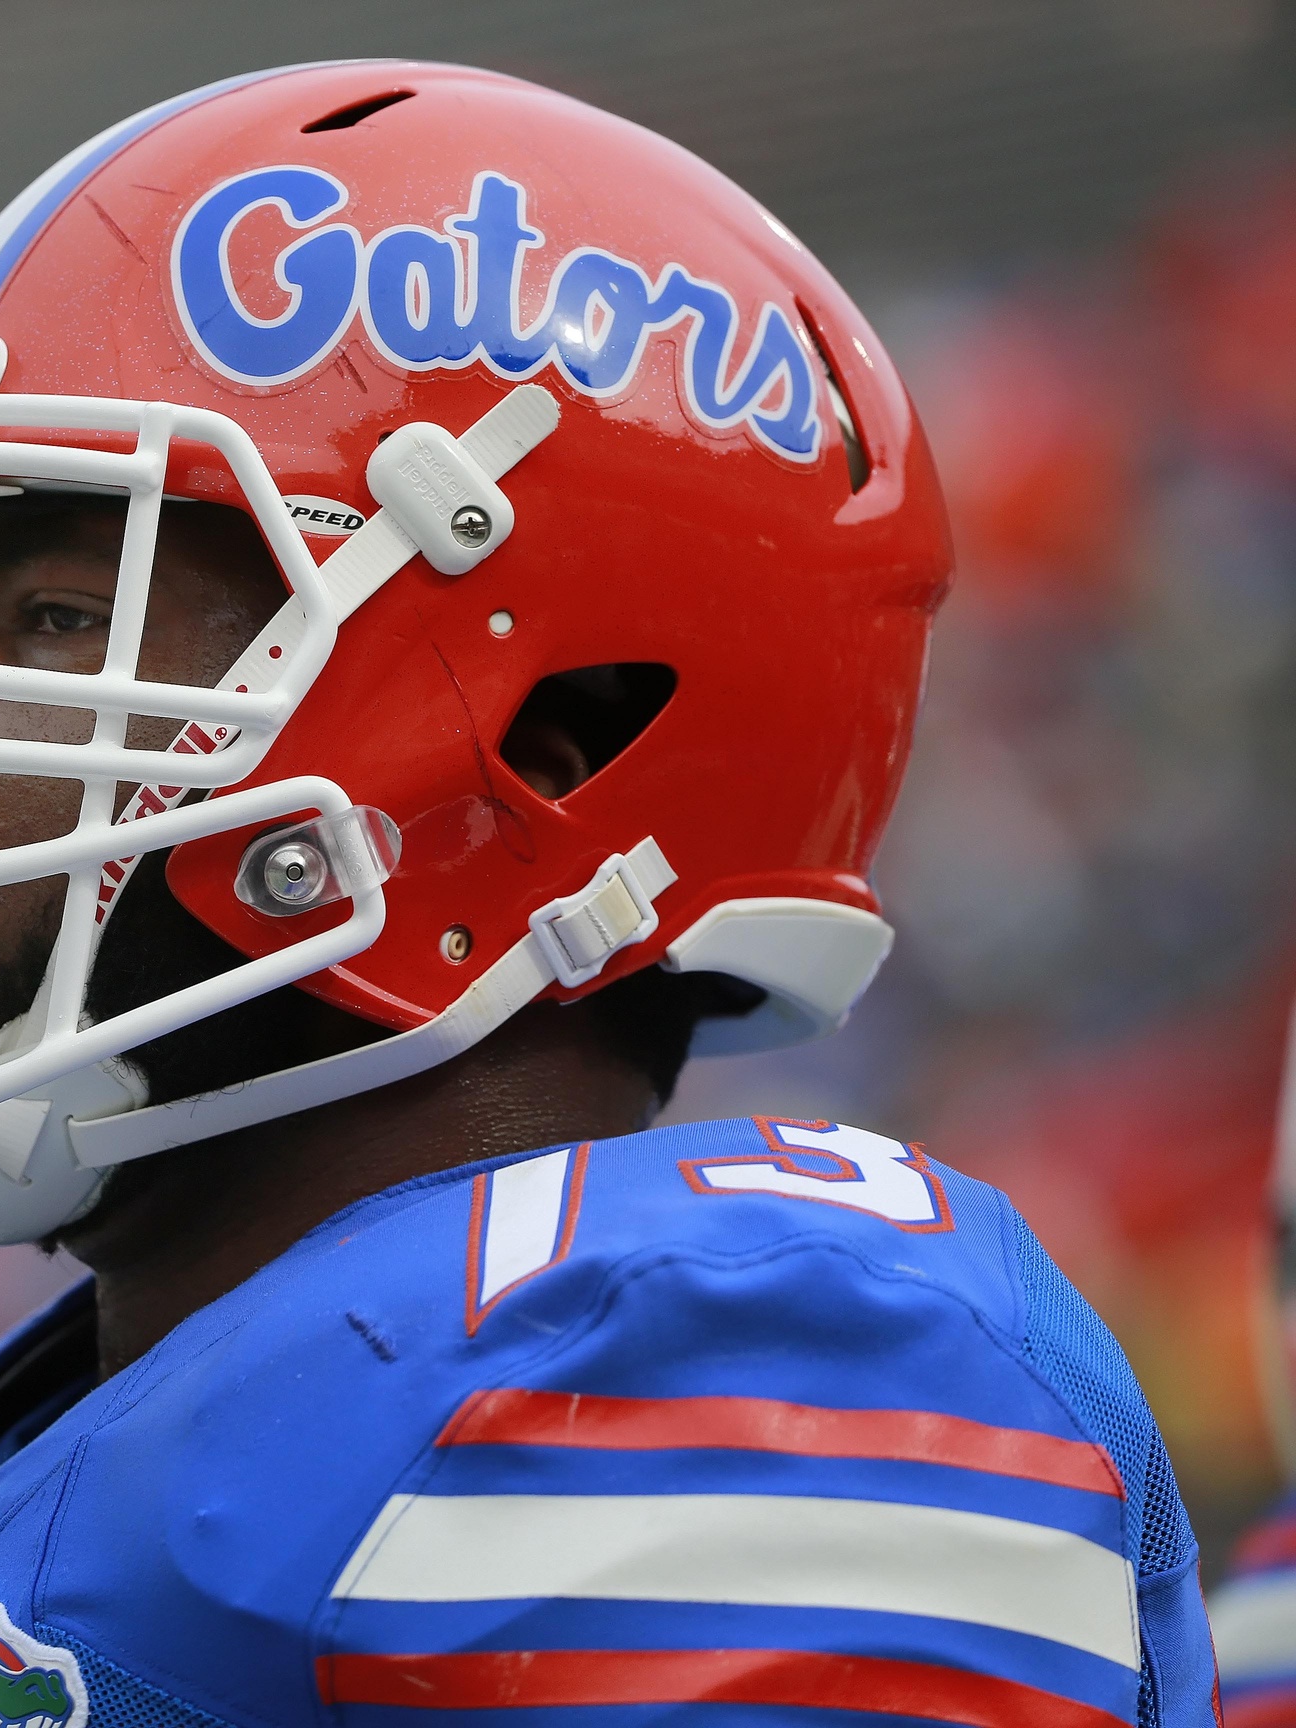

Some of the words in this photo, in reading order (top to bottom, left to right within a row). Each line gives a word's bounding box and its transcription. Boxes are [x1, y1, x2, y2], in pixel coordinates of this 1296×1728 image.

[171, 165, 822, 463] Gators
[397, 459, 453, 521] Riddell
[415, 443, 470, 505] Riddell
[283, 501, 364, 531] PEED
